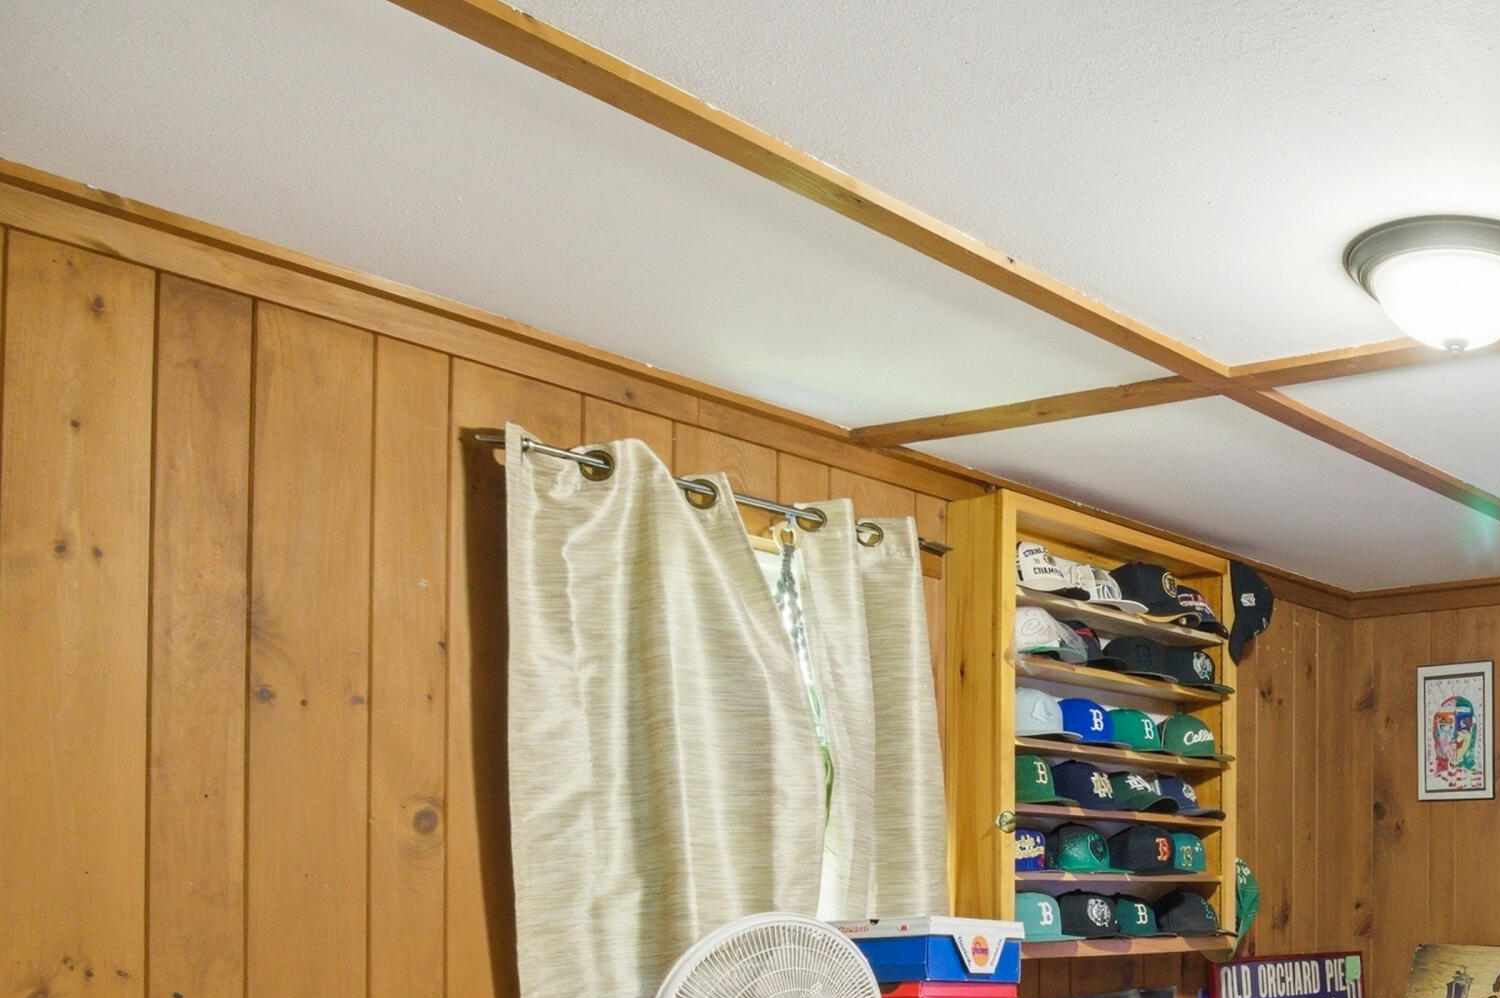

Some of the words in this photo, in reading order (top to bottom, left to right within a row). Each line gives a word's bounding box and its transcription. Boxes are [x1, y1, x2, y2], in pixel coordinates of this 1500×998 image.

[1089, 708, 1104, 731] B
[1141, 718, 1155, 740] B
[1033, 761, 1049, 784] B
[1155, 837, 1172, 861] B
[1037, 901, 1054, 926] B
[1134, 903, 1149, 926] B
[1258, 959, 1321, 998] ORCHARD
